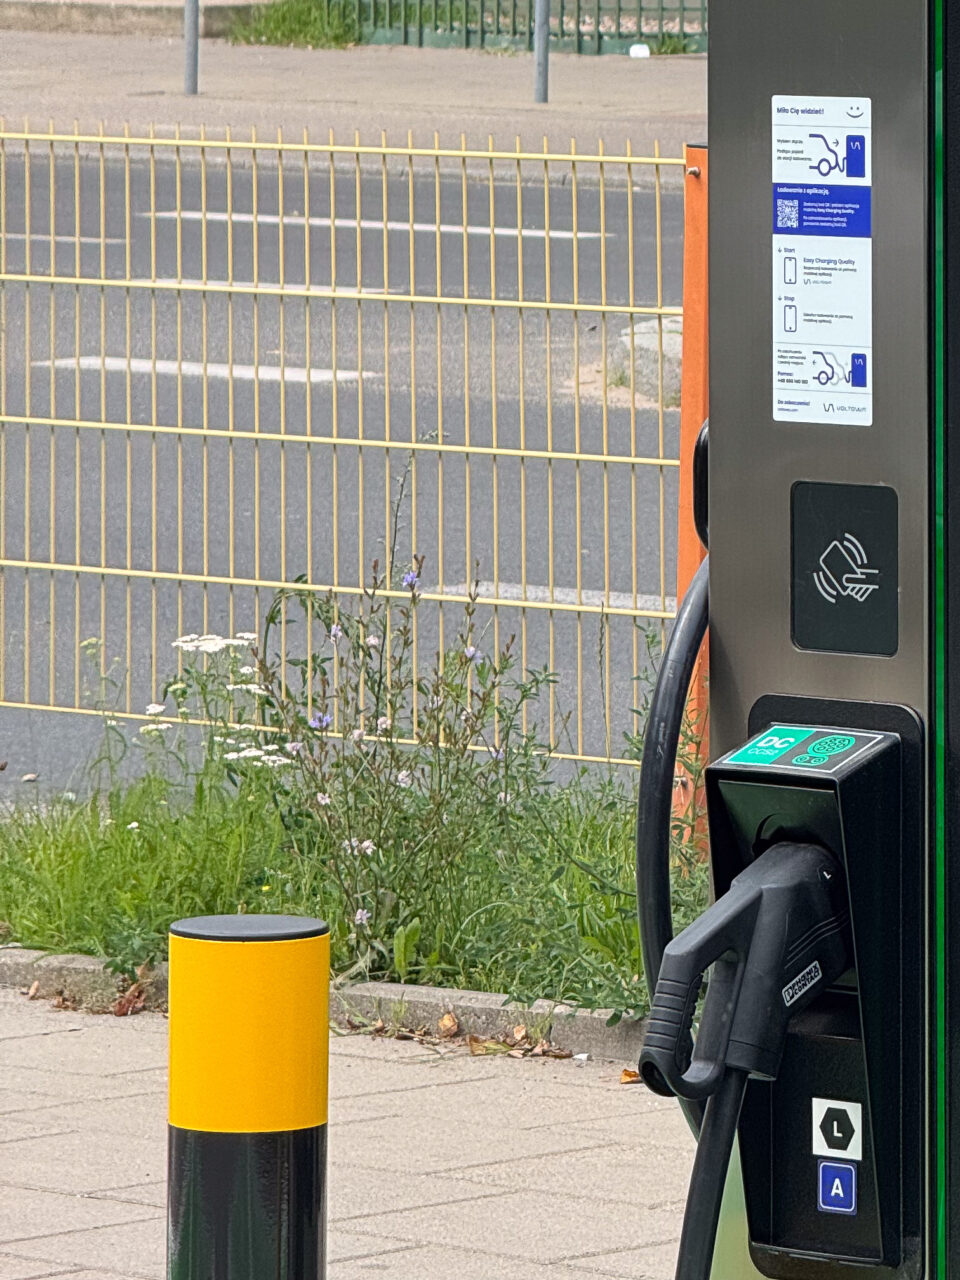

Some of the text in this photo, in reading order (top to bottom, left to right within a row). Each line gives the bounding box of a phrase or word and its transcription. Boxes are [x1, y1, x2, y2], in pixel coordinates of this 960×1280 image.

[757, 736, 795, 748] DC
[833, 1120, 843, 1138] L
[830, 1177, 844, 1198] A
